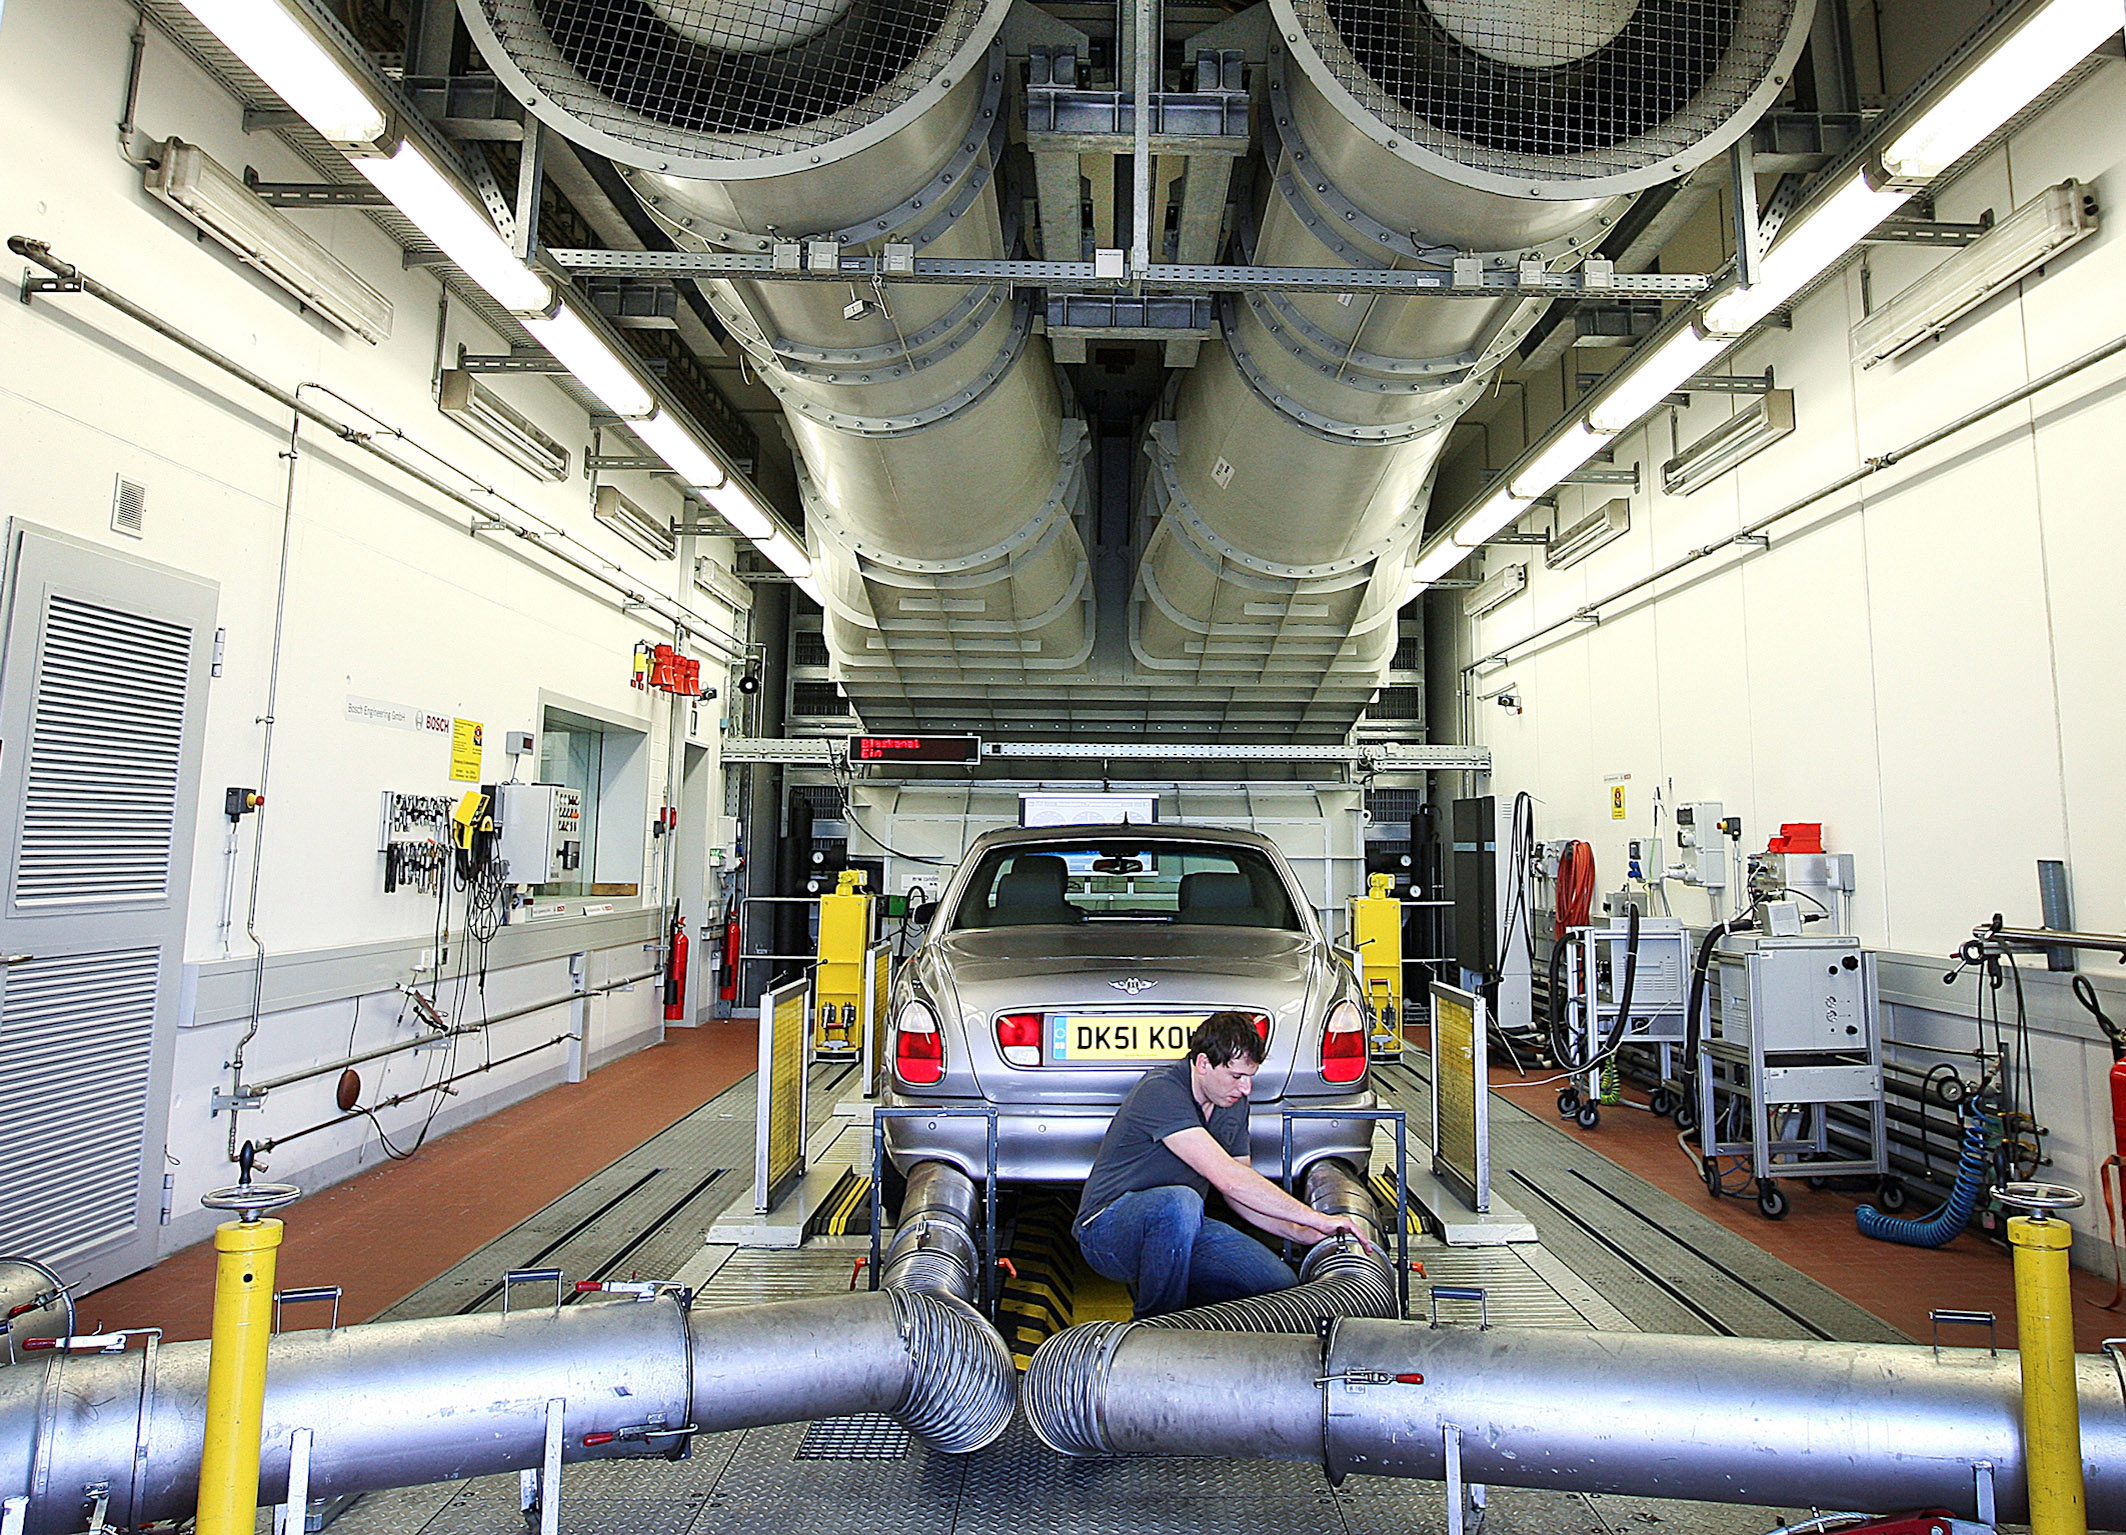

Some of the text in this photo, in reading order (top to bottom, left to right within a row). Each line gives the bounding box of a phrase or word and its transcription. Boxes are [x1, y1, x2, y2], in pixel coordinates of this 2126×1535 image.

[348, 702, 406, 721] Bosch Engineering GmbH
[426, 715, 450, 733] BOSCH
[860, 748, 883, 759] Ein
[1077, 1026, 1137, 1050] DK51
